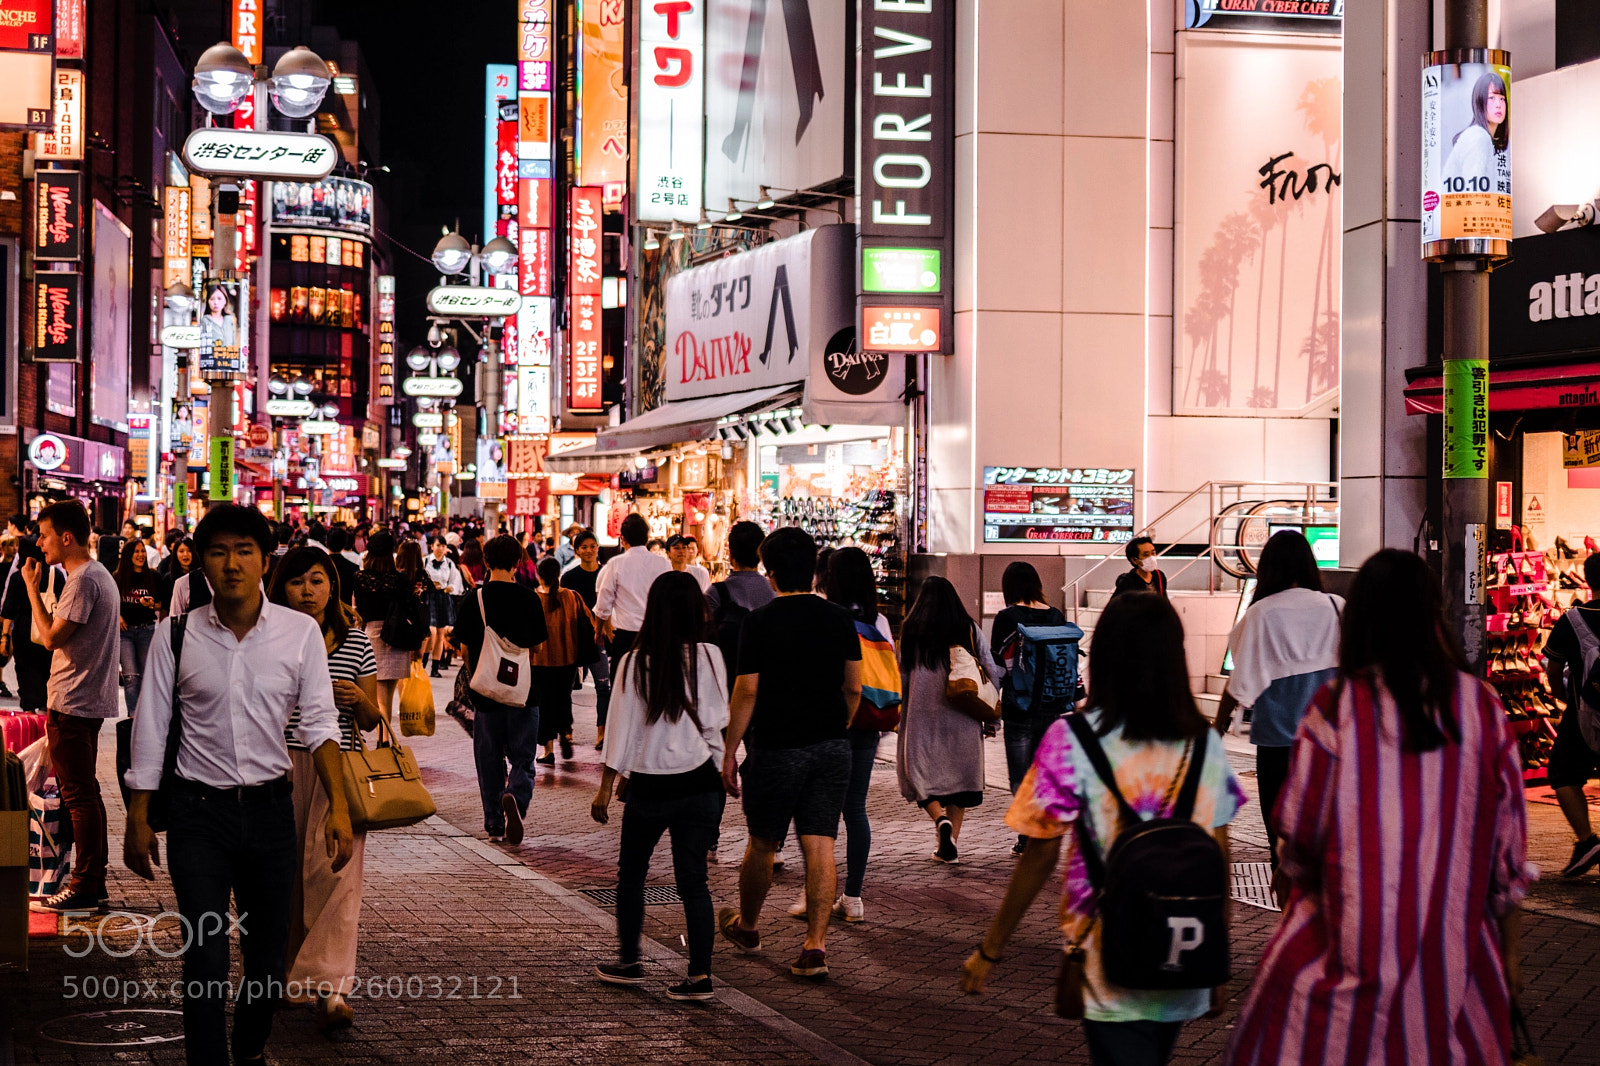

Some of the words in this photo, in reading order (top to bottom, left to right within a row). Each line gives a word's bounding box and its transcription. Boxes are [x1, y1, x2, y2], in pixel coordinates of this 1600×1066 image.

[1301, 1, 1329, 14] CAFE
[32, 36, 48, 49] 1F
[59, 74, 79, 85] 2F
[32, 111, 46, 123] B1
[193, 142, 327, 164] 渋谷センター街
[657, 177, 683, 189] 渋谷
[1443, 176, 1490, 193] 10.10
[39, 183, 49, 207] First
[651, 193, 689, 206] 2号店
[49, 187, 74, 244] Wendy's
[39, 207, 49, 248] Kitchen
[38, 283, 48, 308] First
[48, 287, 73, 345] Wendy's
[37, 308, 48, 348] Kitchen
[576, 341, 598, 355] 2F
[675, 329, 752, 384] DAIWA
[576, 362, 598, 376] 3F
[576, 383, 598, 398] 4F
[1472, 367, 1486, 471] 客引きは犯罪です
[1025, 527, 1048, 540] GRAN
[1160, 916, 1204, 972] P
